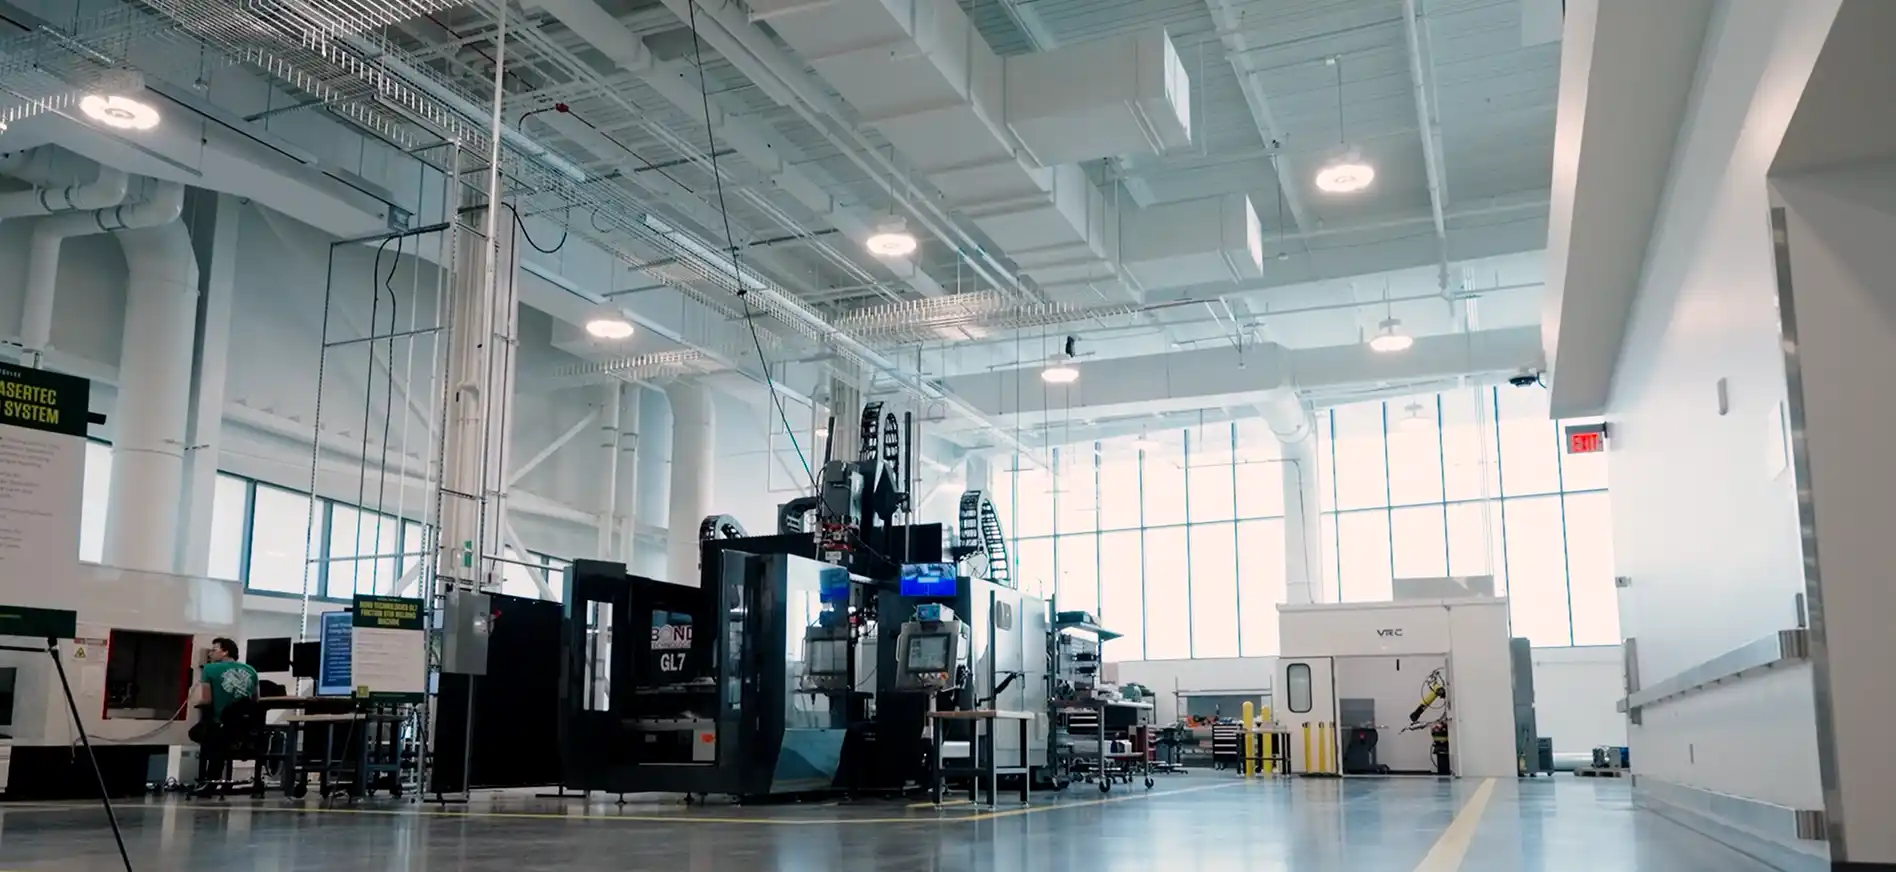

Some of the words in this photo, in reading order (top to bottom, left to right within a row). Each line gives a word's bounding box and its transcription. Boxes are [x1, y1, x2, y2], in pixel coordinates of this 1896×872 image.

[4, 400, 59, 425] SYSTEM
[1571, 433, 1599, 452] EXIT
[1376, 628, 1403, 637] VRC
[660, 653, 686, 671] GL7
